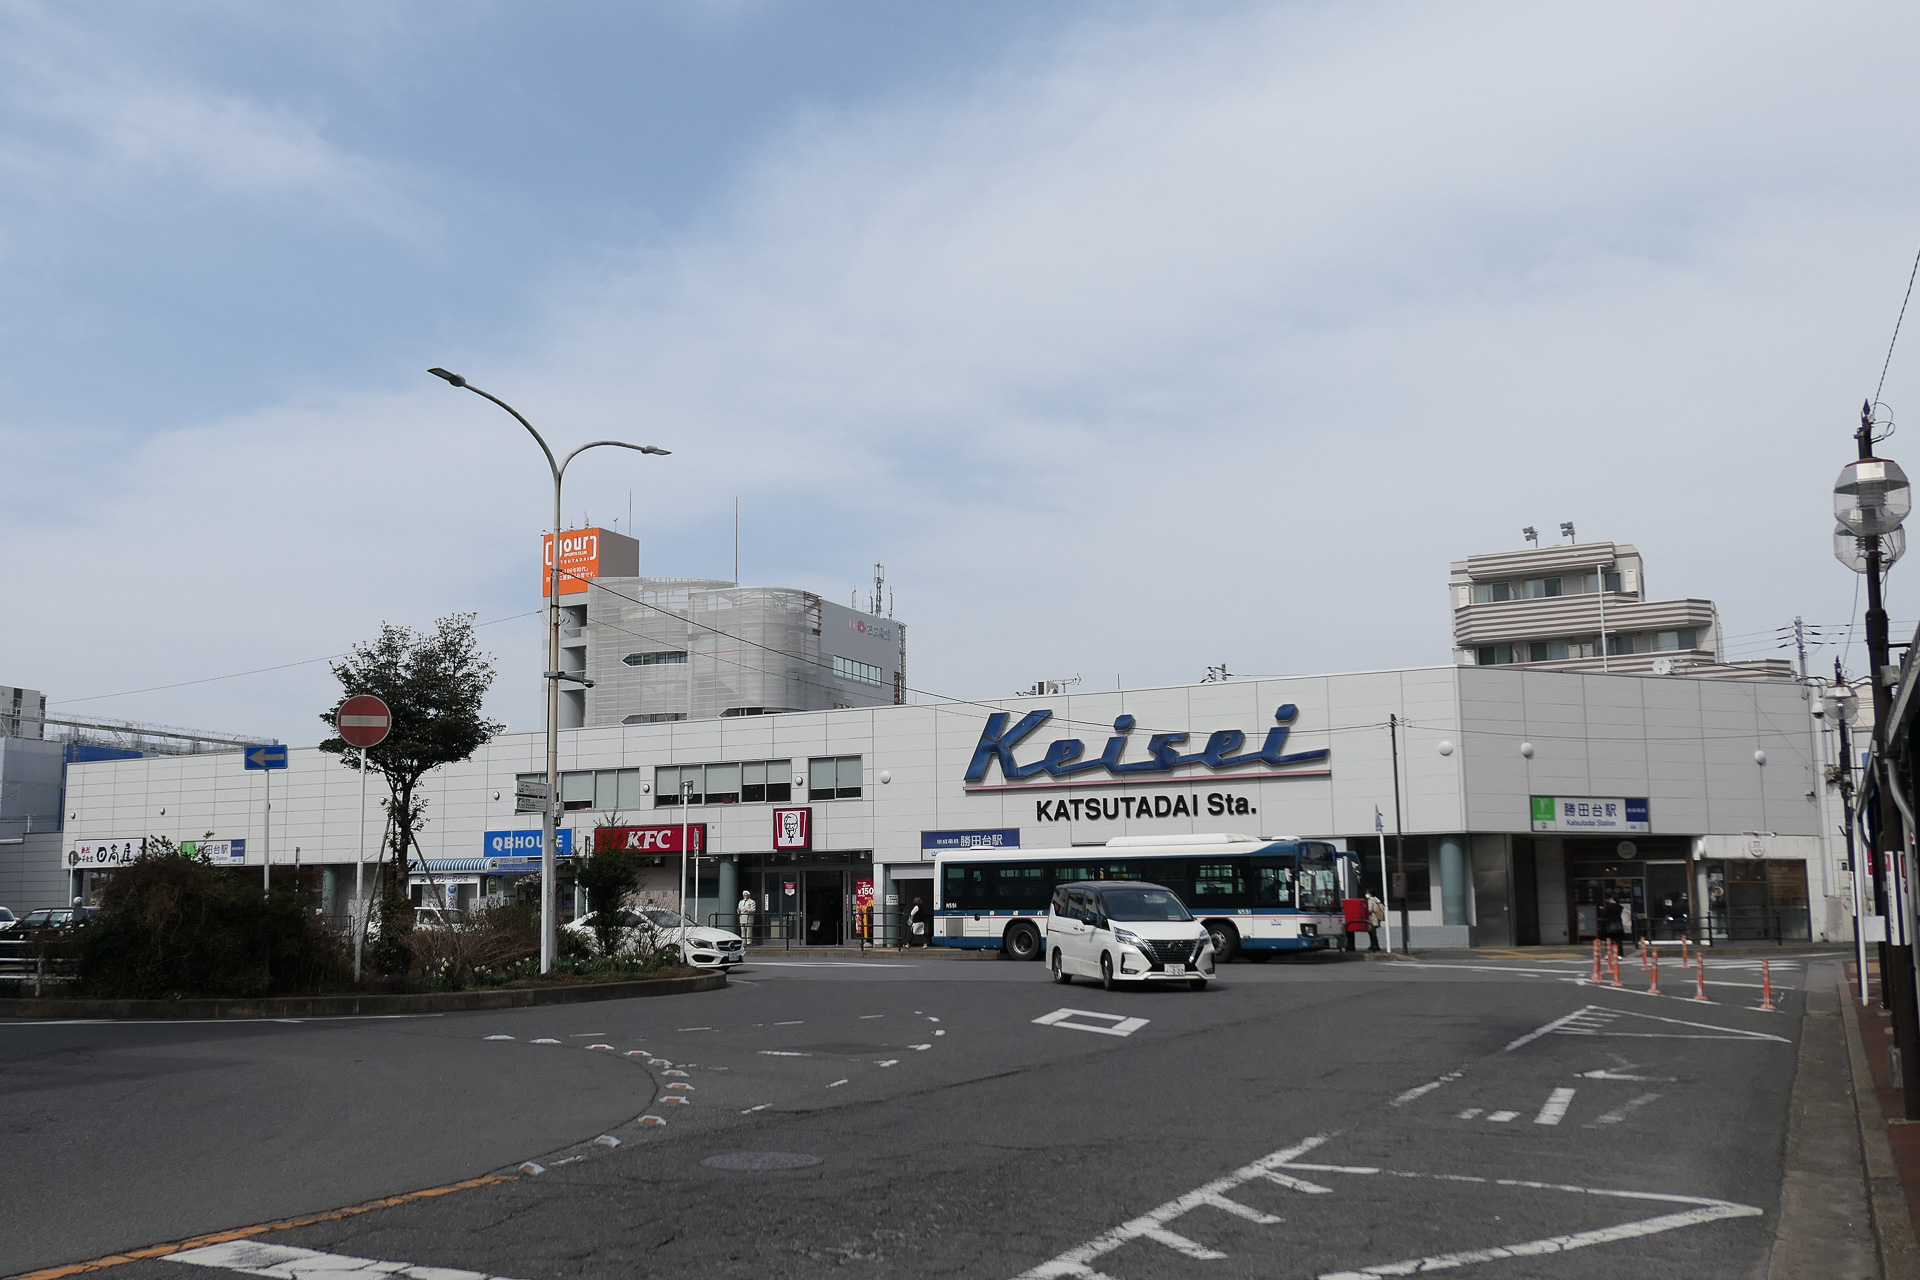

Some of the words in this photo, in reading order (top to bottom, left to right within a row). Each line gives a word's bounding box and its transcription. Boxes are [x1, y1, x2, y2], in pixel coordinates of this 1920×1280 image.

[963, 703, 1330, 781] Keisei
[1036, 794, 1199, 821] KATSUTADAI
[1207, 792, 1257, 816] Sta.
[1564, 803, 1617, 817] 勝田台駅
[492, 835, 563, 851] QBHOUE
[625, 830, 672, 849] KFC
[960, 834, 1003, 846] 勝田台駅
